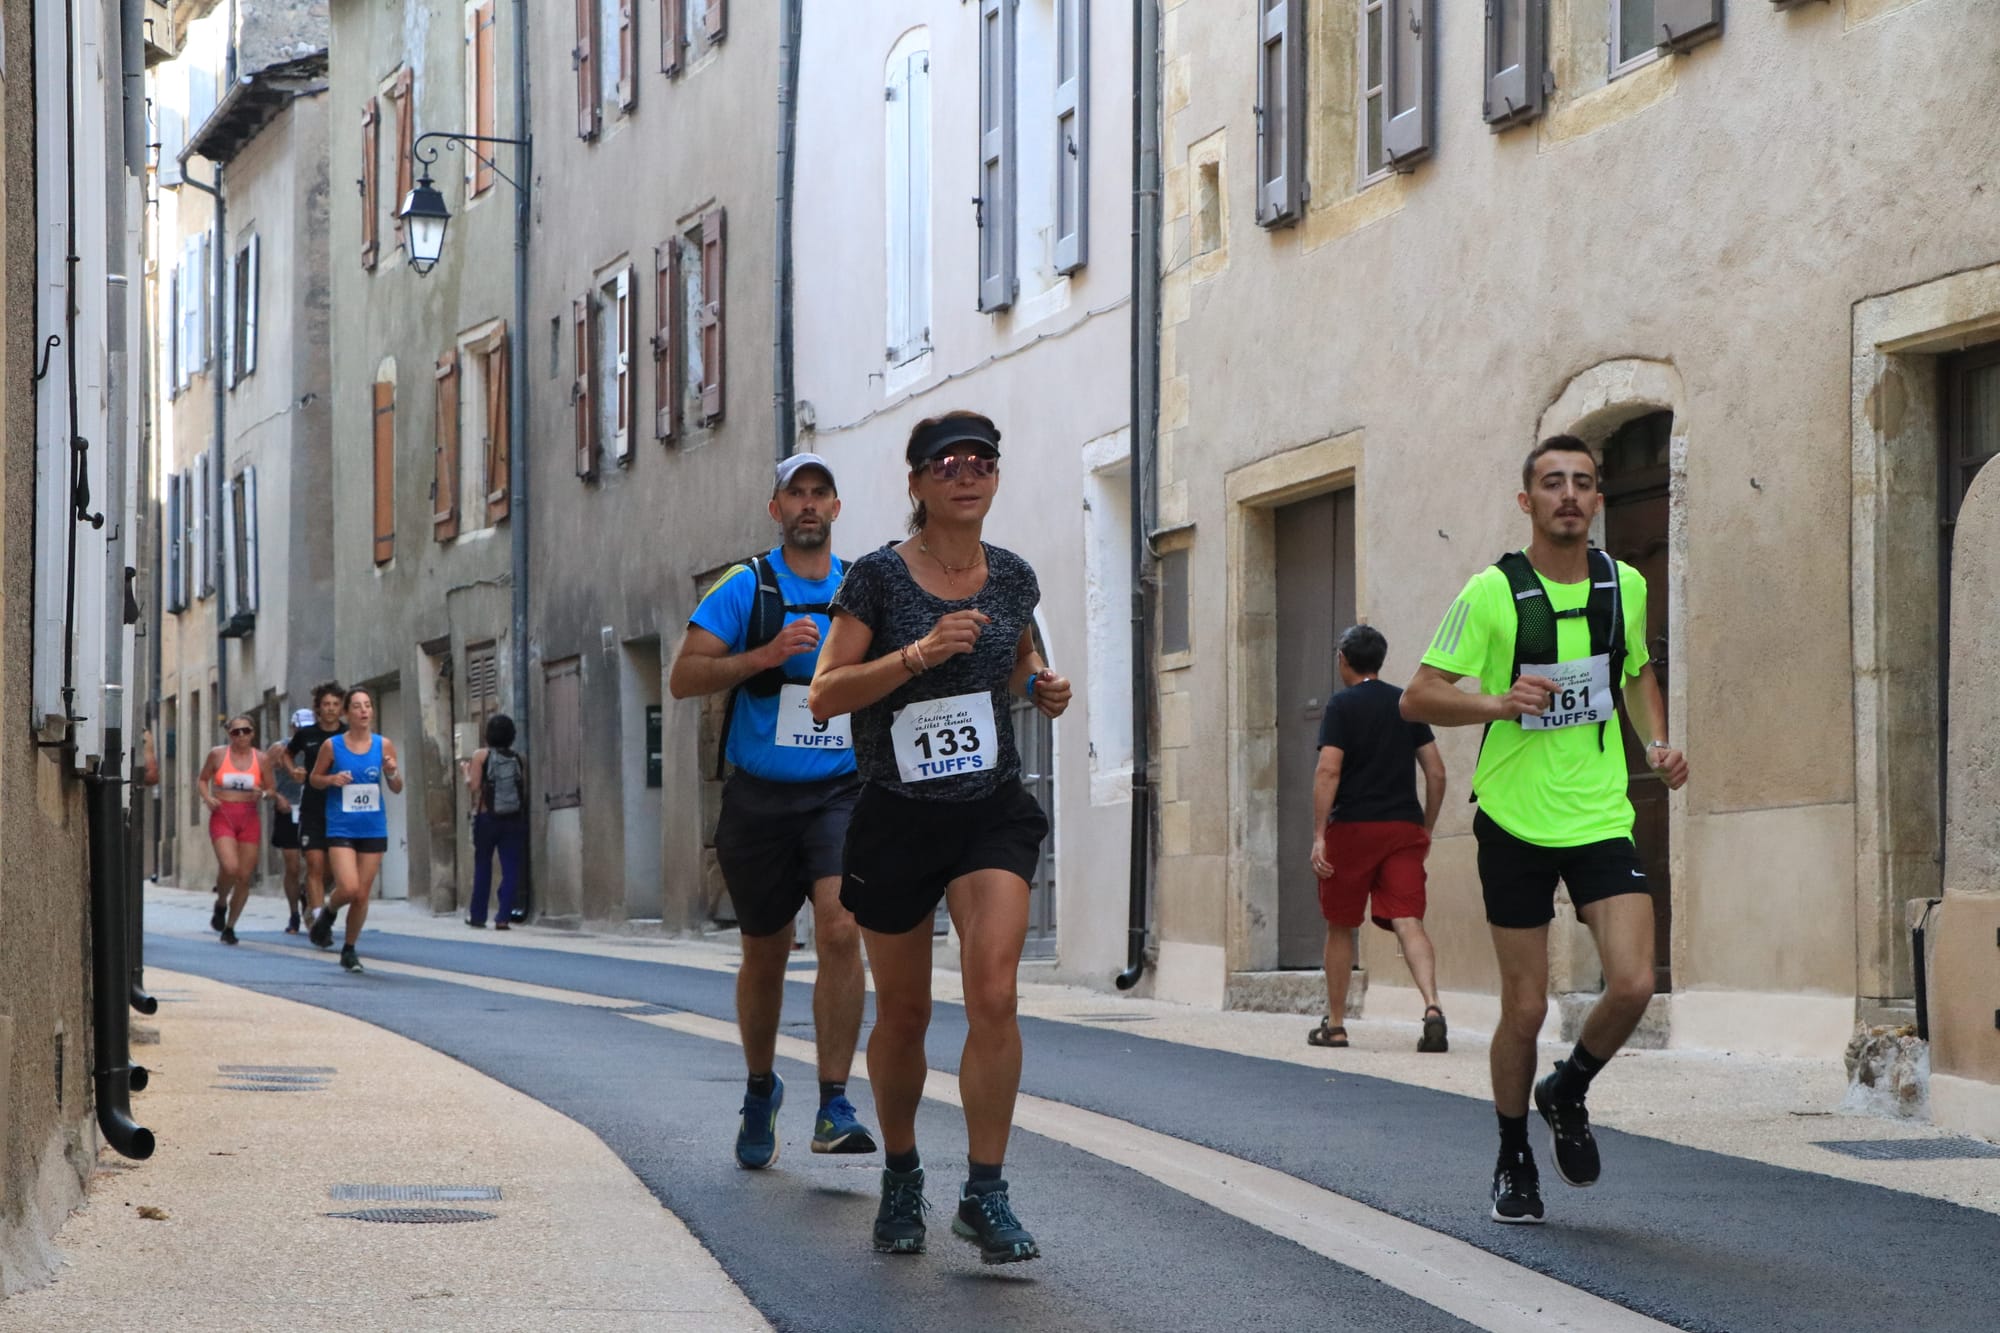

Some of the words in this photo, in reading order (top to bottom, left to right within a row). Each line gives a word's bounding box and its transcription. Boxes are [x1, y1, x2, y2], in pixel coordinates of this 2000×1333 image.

[1549, 686, 1590, 713] 161
[917, 713, 953, 725] Challenge
[956, 711, 968, 719] des
[1540, 709, 1598, 728] TUFF'S
[793, 734, 844, 747] TUFF'S
[914, 725, 981, 760] 133
[917, 755, 984, 777] TUFF'S
[354, 794, 370, 805] 40
